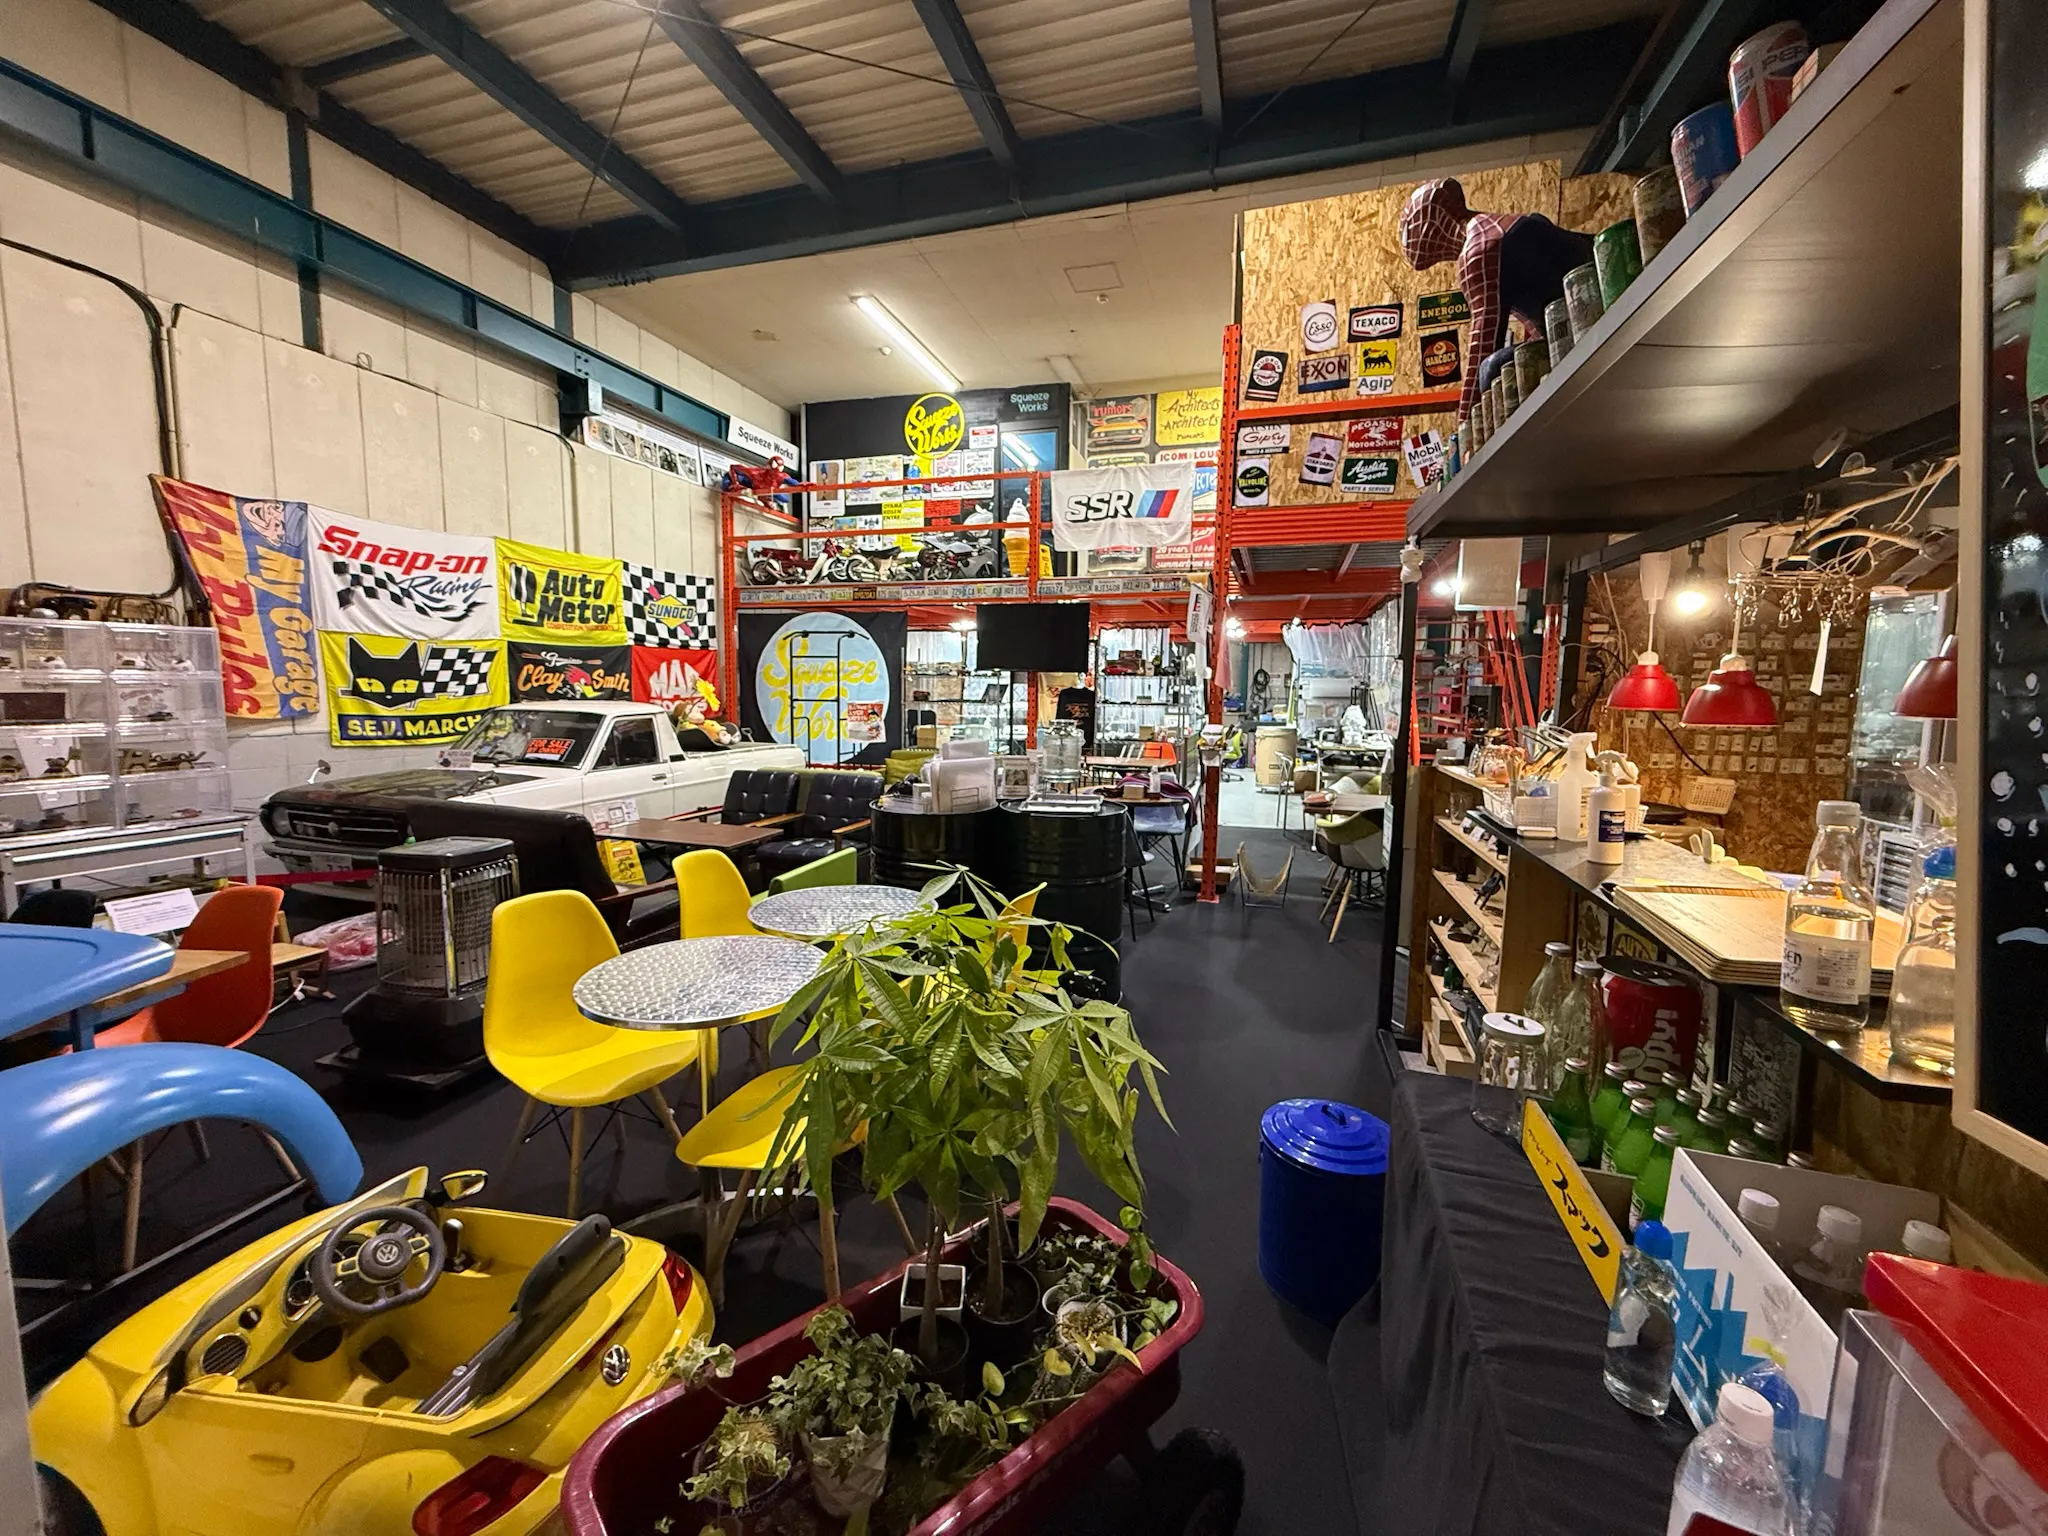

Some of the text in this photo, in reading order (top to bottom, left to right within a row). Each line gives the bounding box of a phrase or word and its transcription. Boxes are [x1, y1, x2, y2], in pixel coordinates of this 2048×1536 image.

[1421, 303, 1469, 319] ENERGOL
[1308, 317, 1333, 337] Esso
[1355, 316, 1396, 329] TEXACO
[1300, 358, 1348, 381] EXXON
[1358, 376, 1393, 391] Agip
[1010, 393, 1050, 403] Squeeze
[1018, 402, 1049, 412] Works
[1162, 397, 1220, 417] Architects
[1160, 415, 1220, 430] Architects
[1351, 420, 1399, 433] PEGASUS
[738, 426, 795, 461] Squeeze Works
[1242, 431, 1287, 446] Gipsy
[1193, 450, 1222, 460] LOU
[1408, 442, 1442, 462] Mobil
[1411, 456, 1434, 468] Racing
[1350, 461, 1389, 476] Austin
[1065, 488, 1134, 523] SSR
[316, 524, 489, 575] Snap-on
[245, 544, 305, 604] My
[541, 569, 605, 599] Auto
[396, 573, 494, 599] Racing
[537, 595, 616, 625] Meter
[648, 602, 694, 620] SUNOCO
[270, 606, 321, 713] Garage
[517, 664, 630, 692] Clay Smith
[404, 714, 482, 738] MARCH
